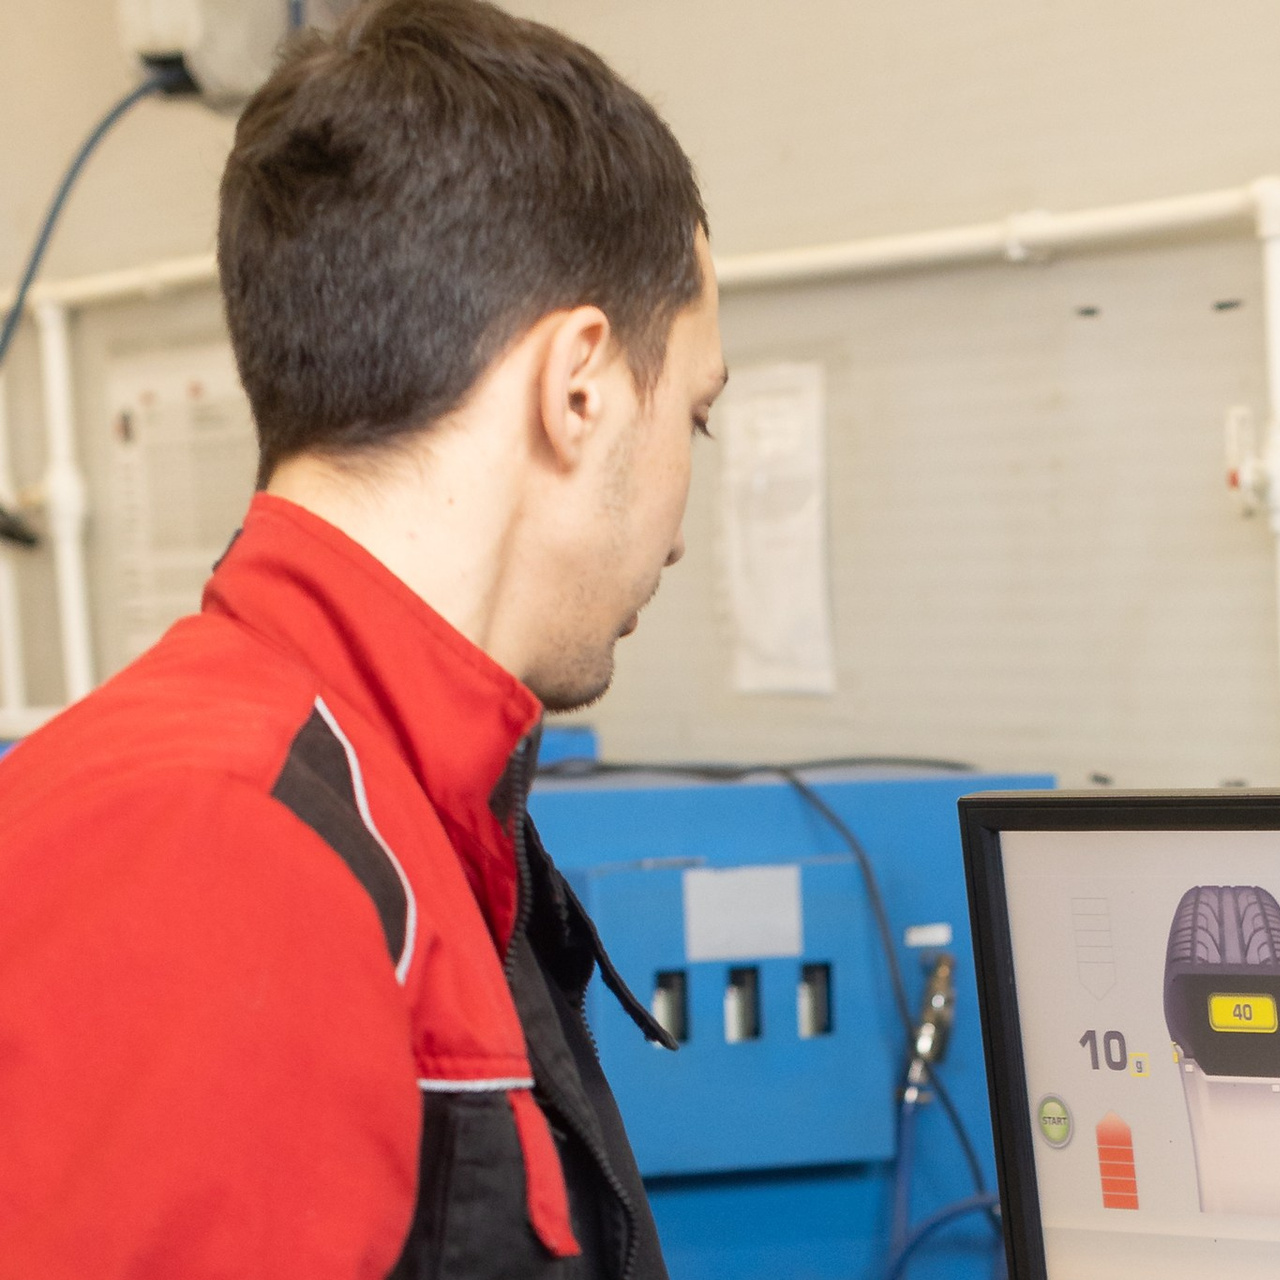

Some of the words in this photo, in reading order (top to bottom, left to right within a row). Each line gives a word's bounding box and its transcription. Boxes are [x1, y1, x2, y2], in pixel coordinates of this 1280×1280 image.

[1232, 1003, 1253, 1021] 40
[1078, 1029, 1127, 1071] 10
[1042, 1116, 1068, 1125] START
